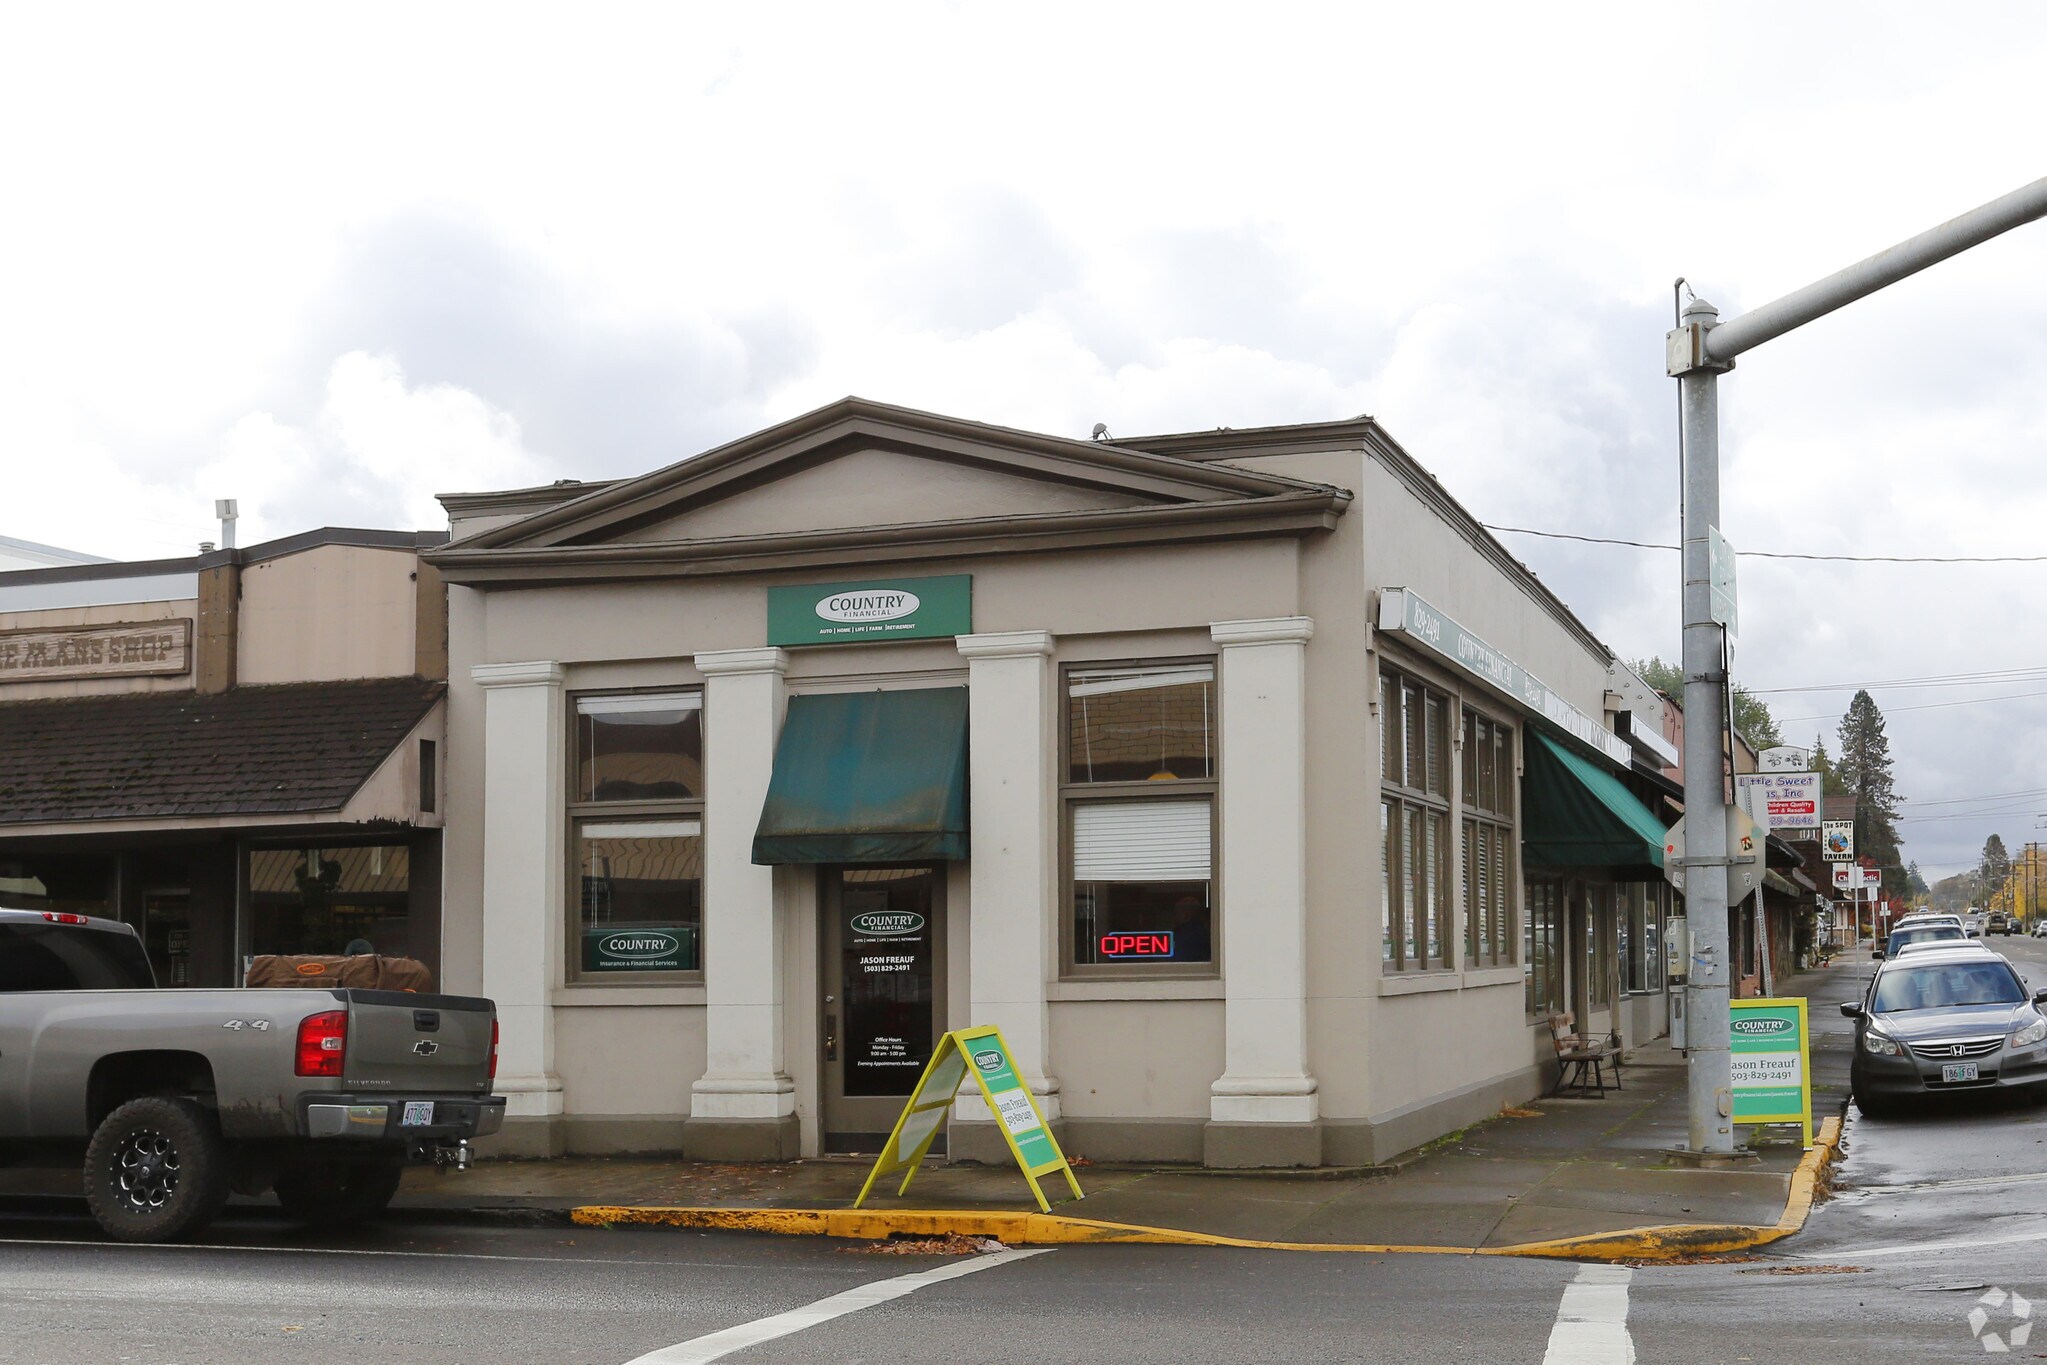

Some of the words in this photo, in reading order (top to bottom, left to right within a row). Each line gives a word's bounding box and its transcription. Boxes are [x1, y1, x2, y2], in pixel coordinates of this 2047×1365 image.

[829, 595, 905, 611] COUNTRY
[109, 634, 173, 664] SHOP
[1739, 776, 1772, 787] Lttle
[1777, 775, 1814, 787] Sweet
[1783, 788, 1804, 798] Inc
[861, 915, 915, 926] COUNTRY
[609, 939, 667, 950] COUNTRY
[1101, 935, 1169, 955] OPEN
[860, 956, 885, 964] JASON
[886, 955, 915, 964] FREAUF
[864, 965, 881, 973] (503)
[881, 964, 910, 972] 829-2491
[1735, 1020, 1785, 1030] COUNTRY
[975, 1052, 999, 1066] COUNTRY
[1731, 1062, 1757, 1070] ason
[1760, 1058, 1796, 1069] Freauf
[1731, 1070, 1791, 1081] 503-829-2491
[1945, 1068, 1958, 1079] 186
[1962, 1066, 1976, 1077] FGY
